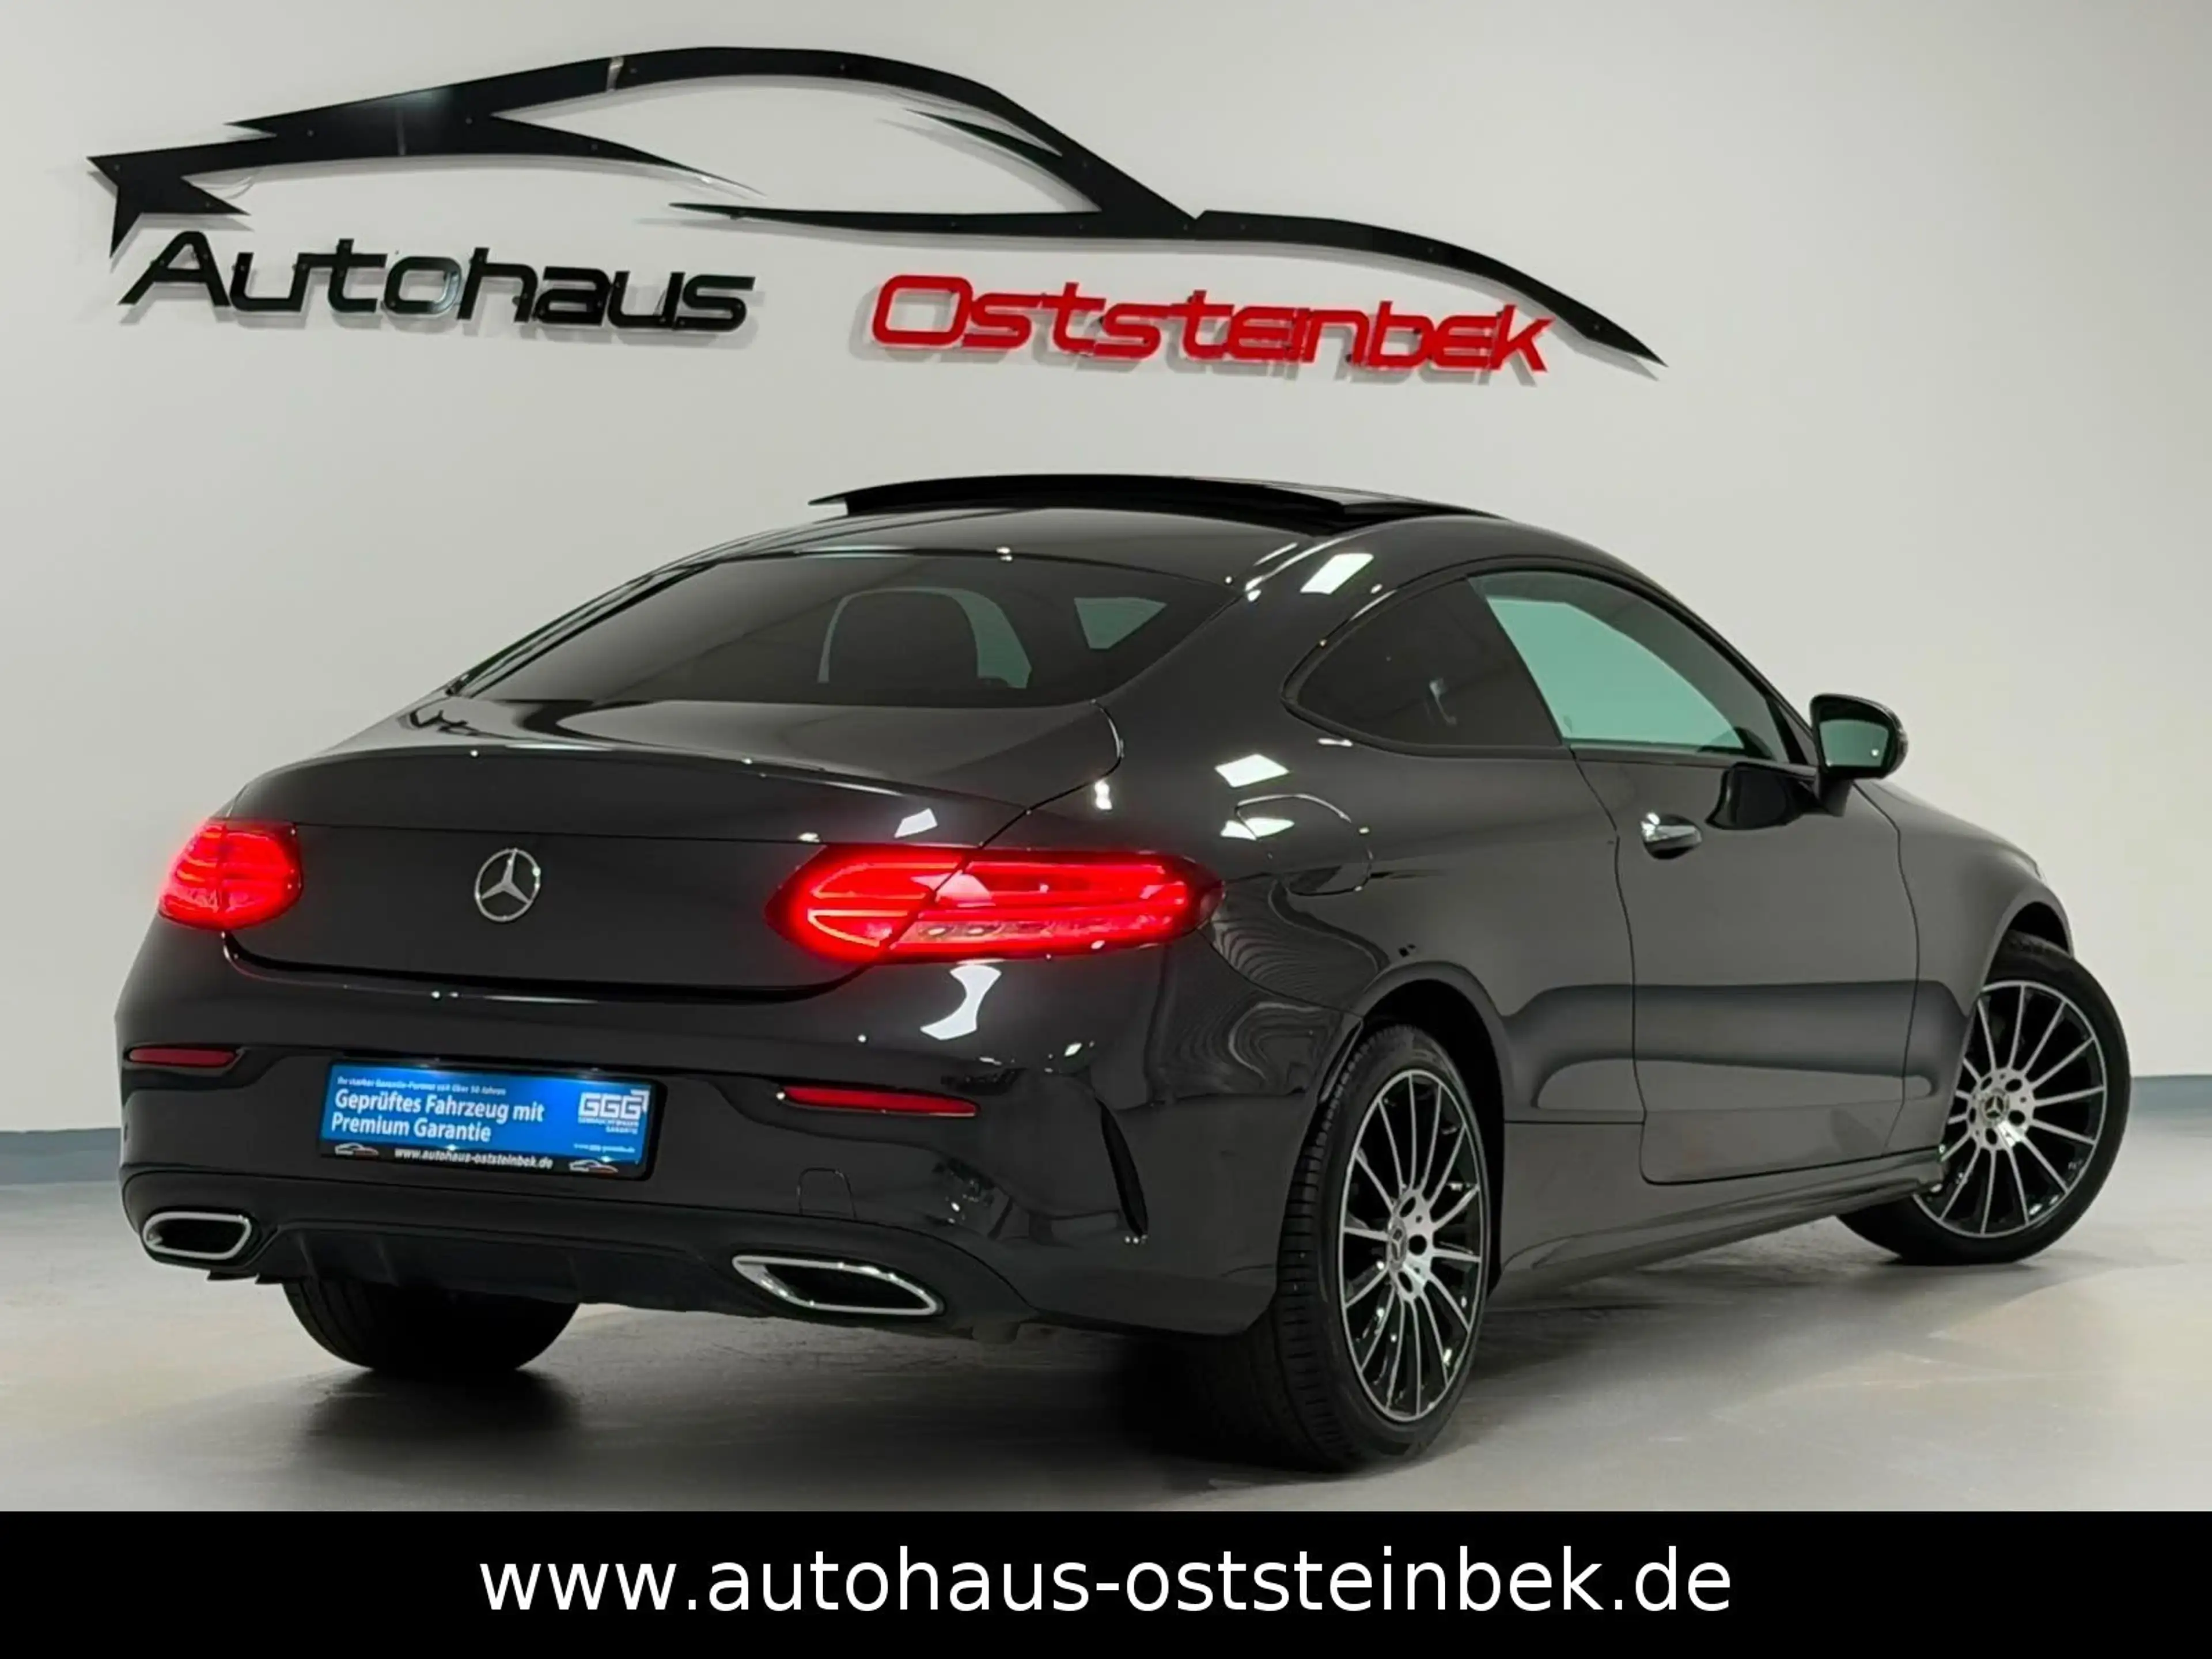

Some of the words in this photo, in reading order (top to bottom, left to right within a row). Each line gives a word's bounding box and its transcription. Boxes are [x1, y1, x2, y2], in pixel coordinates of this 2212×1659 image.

[120, 230, 755, 332] Autohaus
[872, 275, 1553, 372] Oststeinbek
[335, 1088, 421, 1114] Geprüftes
[425, 1094, 509, 1125] Fahrzeug
[513, 1101, 545, 1122] mit
[578, 1092, 642, 1120] GGG
[331, 1111, 410, 1137] Premium
[414, 1117, 491, 1142] Garantie
[395, 1148, 554, 1169] www.autohaus-oststeinbek.de
